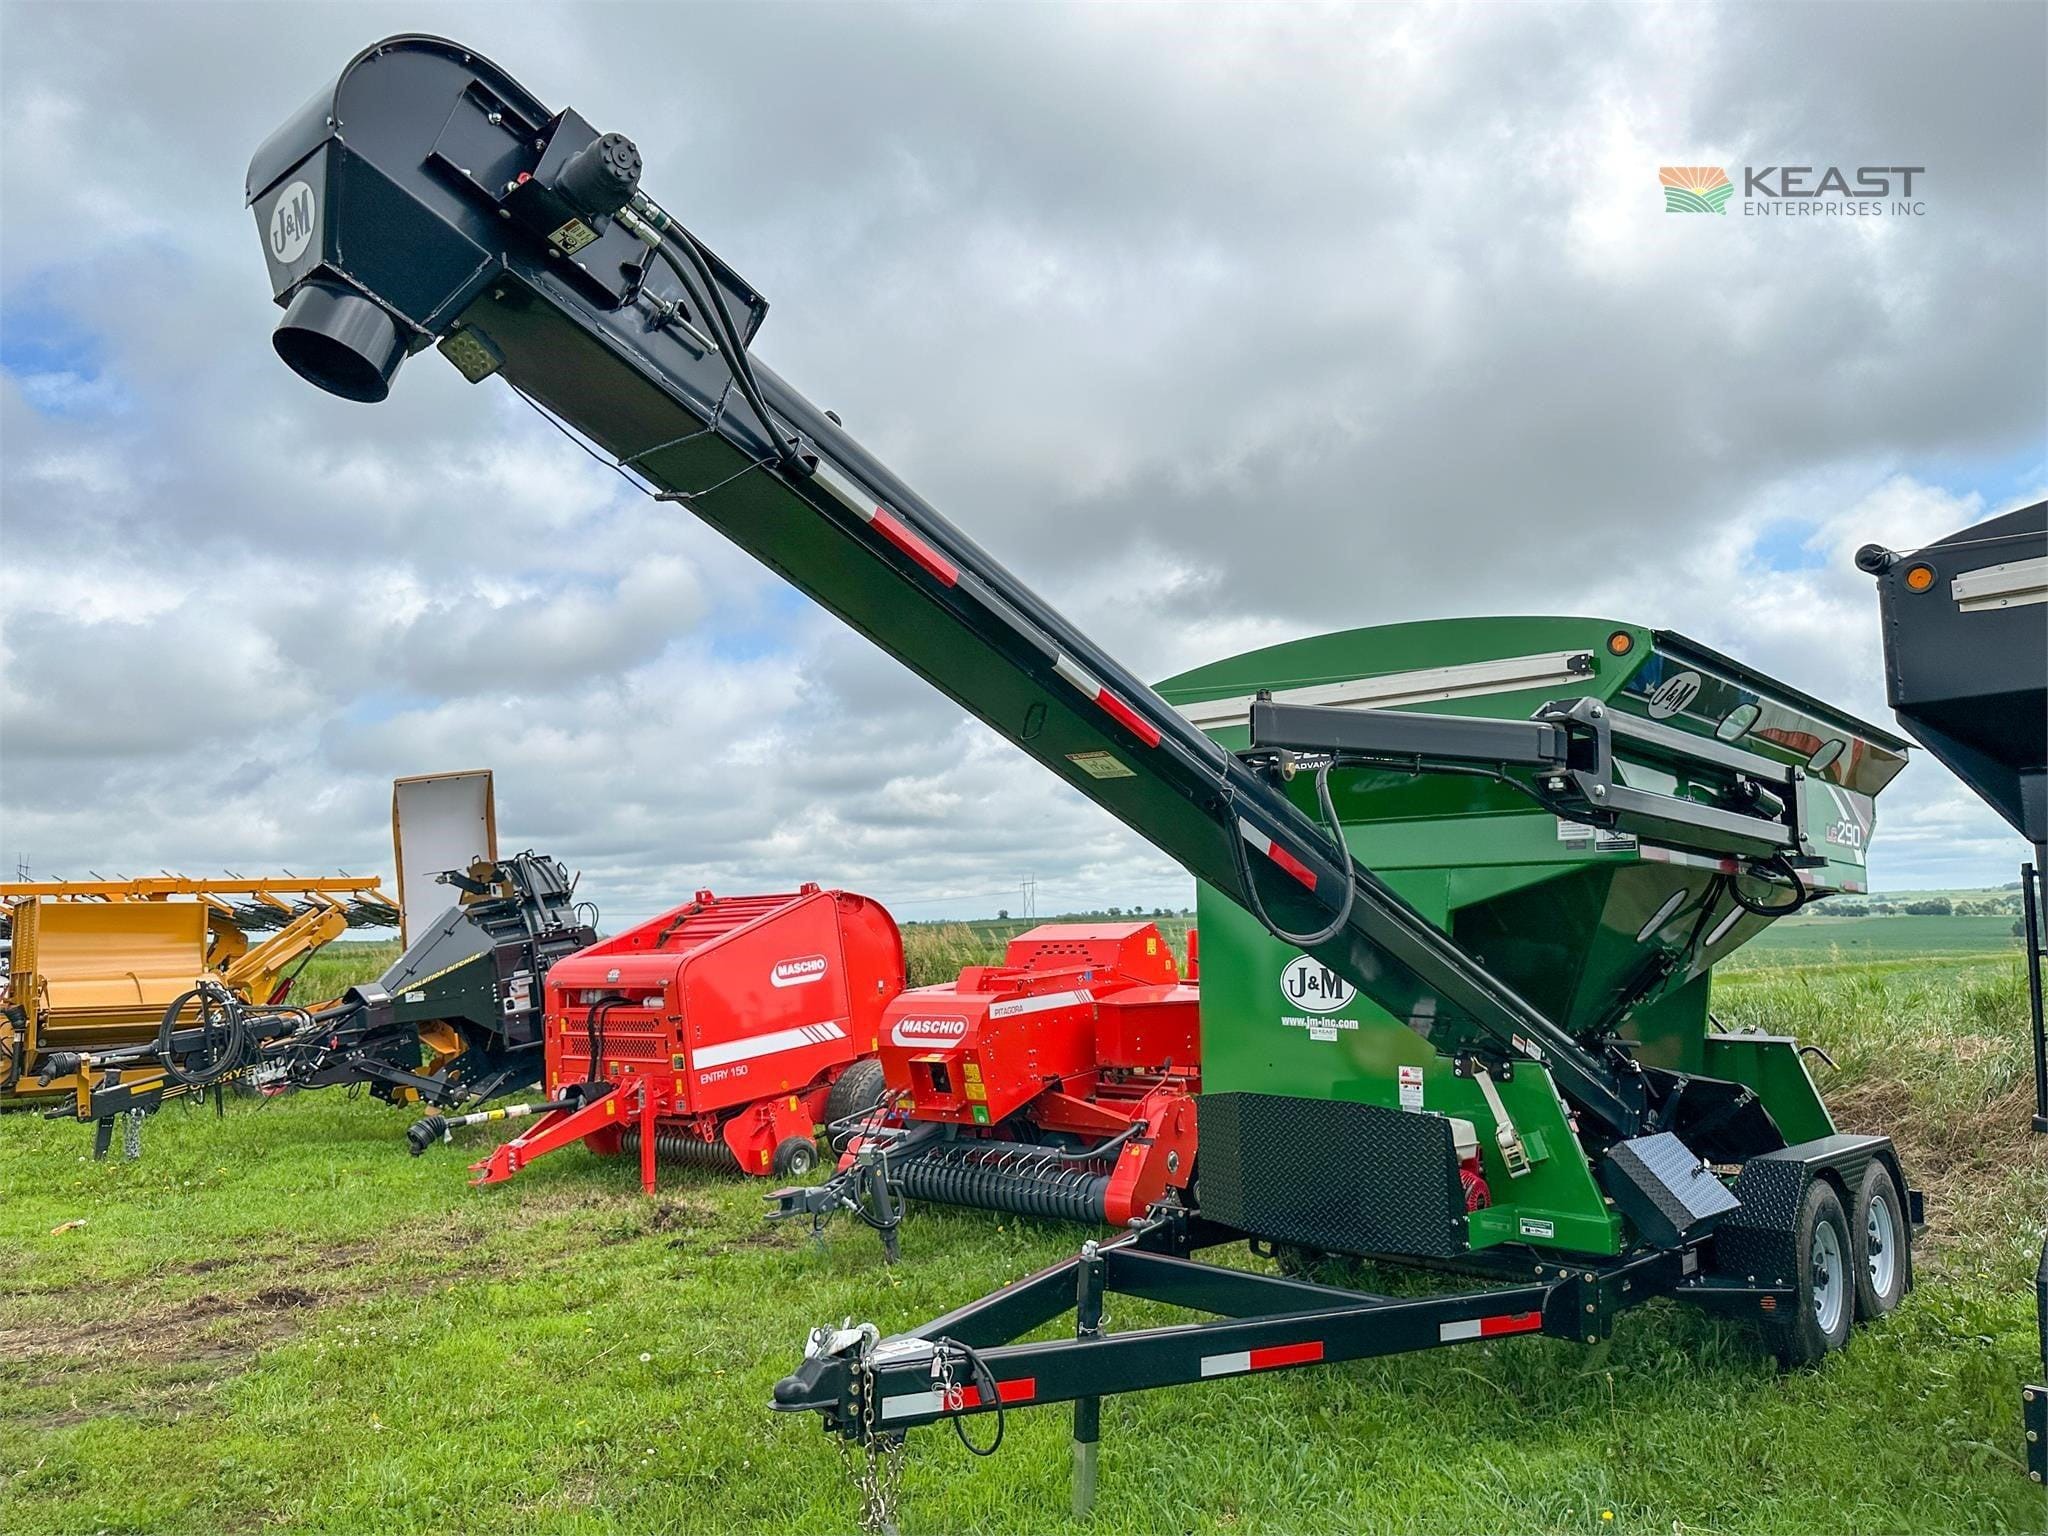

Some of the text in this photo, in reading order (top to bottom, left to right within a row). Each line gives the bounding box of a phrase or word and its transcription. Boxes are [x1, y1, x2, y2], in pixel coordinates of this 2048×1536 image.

[273, 188, 311, 254] J&M
[1651, 679, 1698, 713] J&M
[1295, 760, 1331, 770] ADVAN
[777, 958, 825, 977] MASCHIO
[1287, 967, 1344, 999] J&M
[994, 1005, 1024, 1016] PITAGORA
[901, 1020, 965, 1034] MASCHIO
[700, 1065, 748, 1085] ENTRY 150
